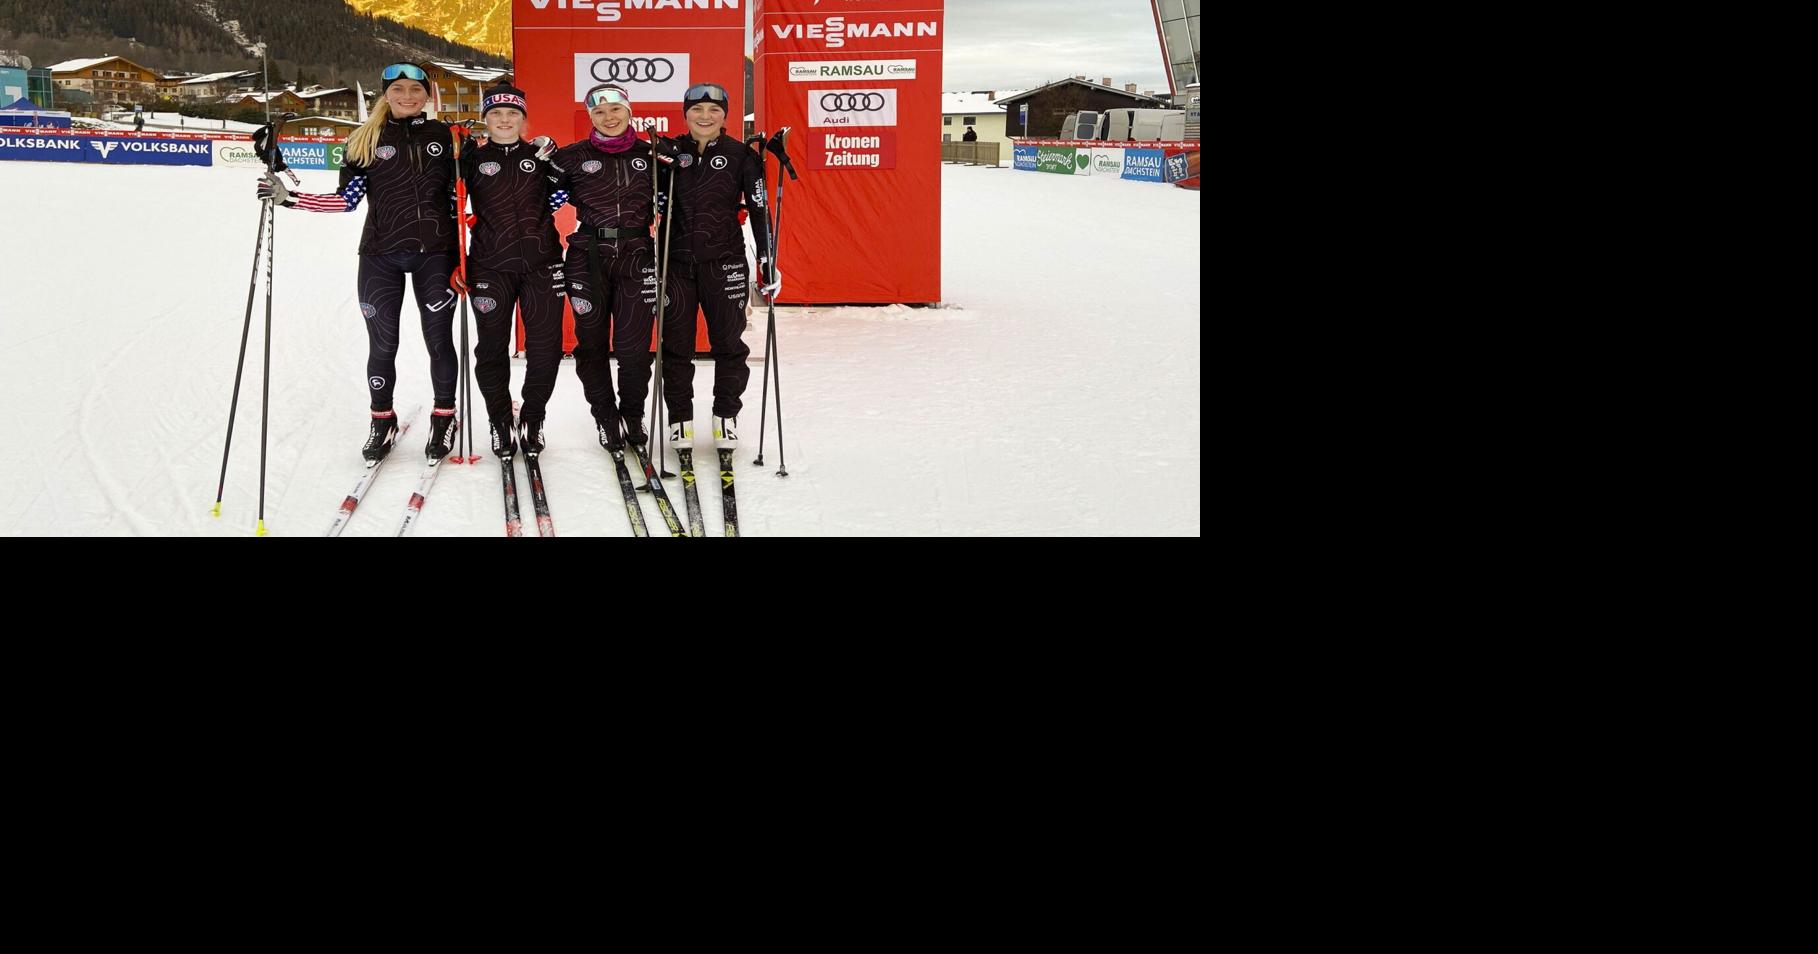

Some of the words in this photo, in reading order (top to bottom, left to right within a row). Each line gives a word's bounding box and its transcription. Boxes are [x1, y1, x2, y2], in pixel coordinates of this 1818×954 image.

[771, 16, 937, 48] VIESSMANN
[820, 65, 884, 76] RAMSAU
[491, 93, 518, 104] USA
[825, 134, 880, 149] Kronen
[121, 141, 208, 154] VOLKSBANK
[282, 147, 325, 158] AMSAU
[229, 151, 259, 159] RAMSA
[282, 156, 325, 165] ACHSTEIN
[825, 152, 880, 168] Zeitung
[1126, 156, 1162, 168] RAMSAU
